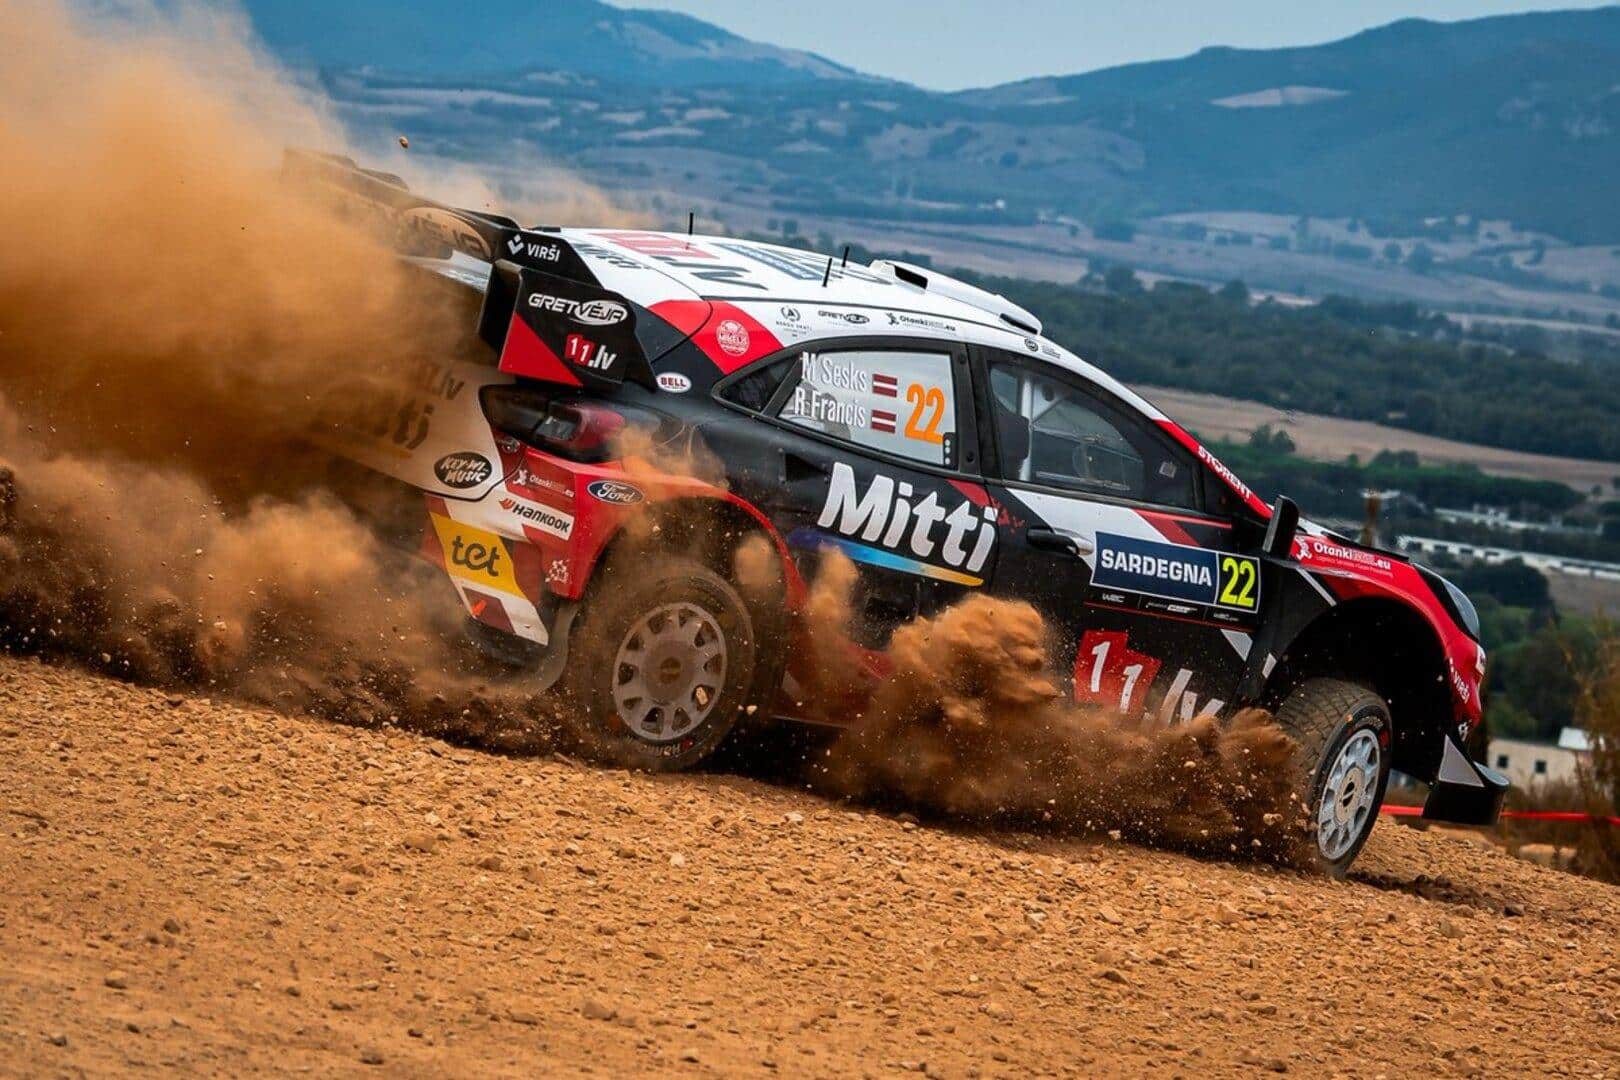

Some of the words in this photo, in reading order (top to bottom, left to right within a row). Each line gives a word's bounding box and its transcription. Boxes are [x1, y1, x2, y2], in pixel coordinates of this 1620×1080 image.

[527, 242, 561, 262] VIRŠI
[569, 337, 617, 370] 11.lv
[801, 352, 817, 381] M
[821, 357, 867, 392] Sesks
[660, 376, 687, 388] BELL
[795, 387, 806, 417] R
[811, 389, 866, 428] Francis
[904, 383, 946, 446] 22
[444, 468, 487, 484] MUSIC
[596, 481, 636, 503] Ford
[1198, 445, 1253, 500] STORENT
[817, 462, 998, 573] Mitti
[452, 536, 500, 576] tet
[1101, 549, 1212, 587] SARDEGNA
[1220, 557, 1256, 607] 22
